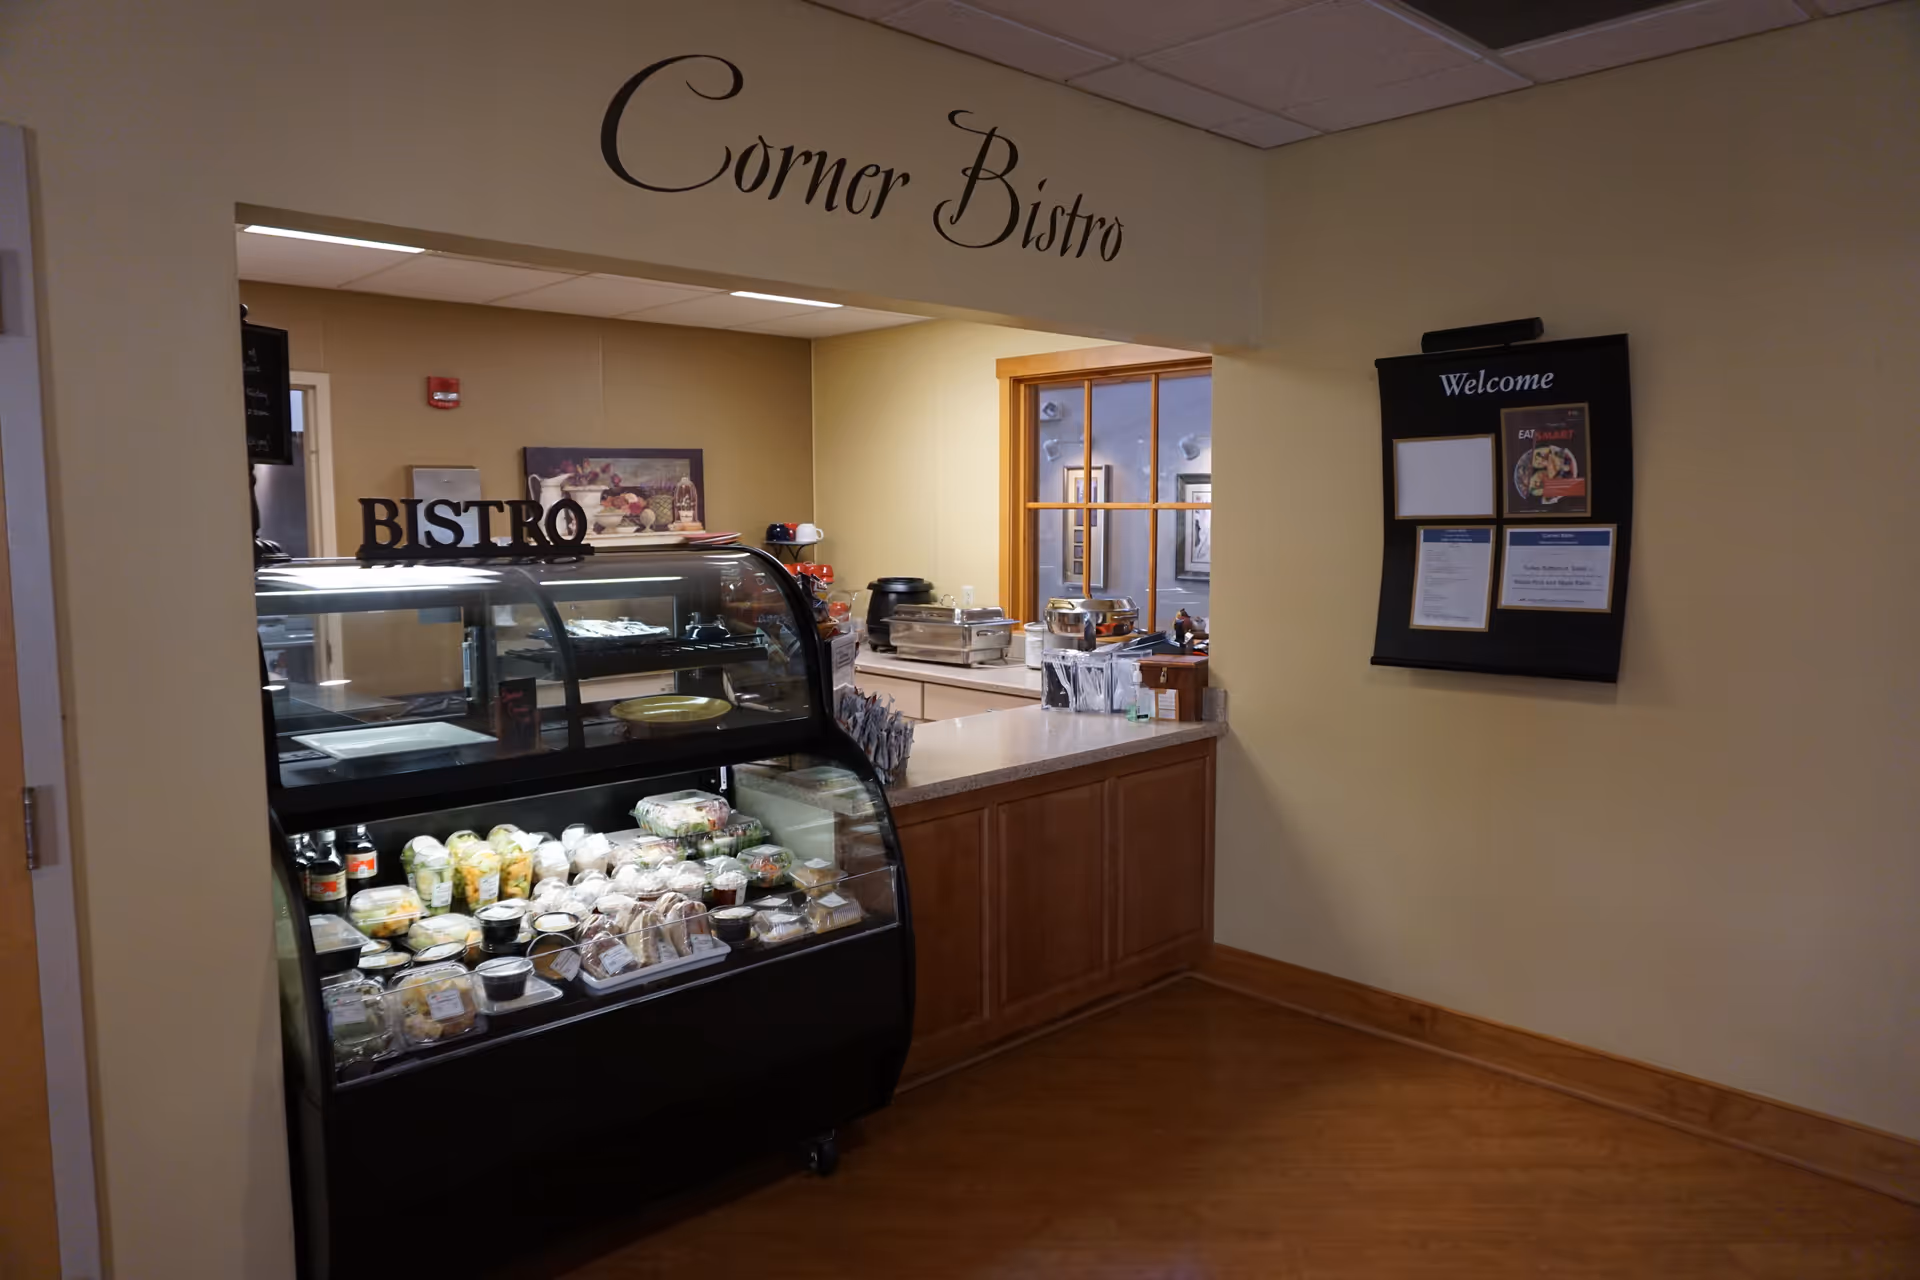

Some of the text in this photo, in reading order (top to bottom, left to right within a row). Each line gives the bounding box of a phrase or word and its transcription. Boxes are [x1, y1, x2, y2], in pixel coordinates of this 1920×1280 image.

[600, 54, 1124, 262] Corner Bistro
[1440, 370, 1554, 396] Welcome
[1518, 429, 1575, 441] EAT SMART
[359, 497, 588, 550] BISTRO
